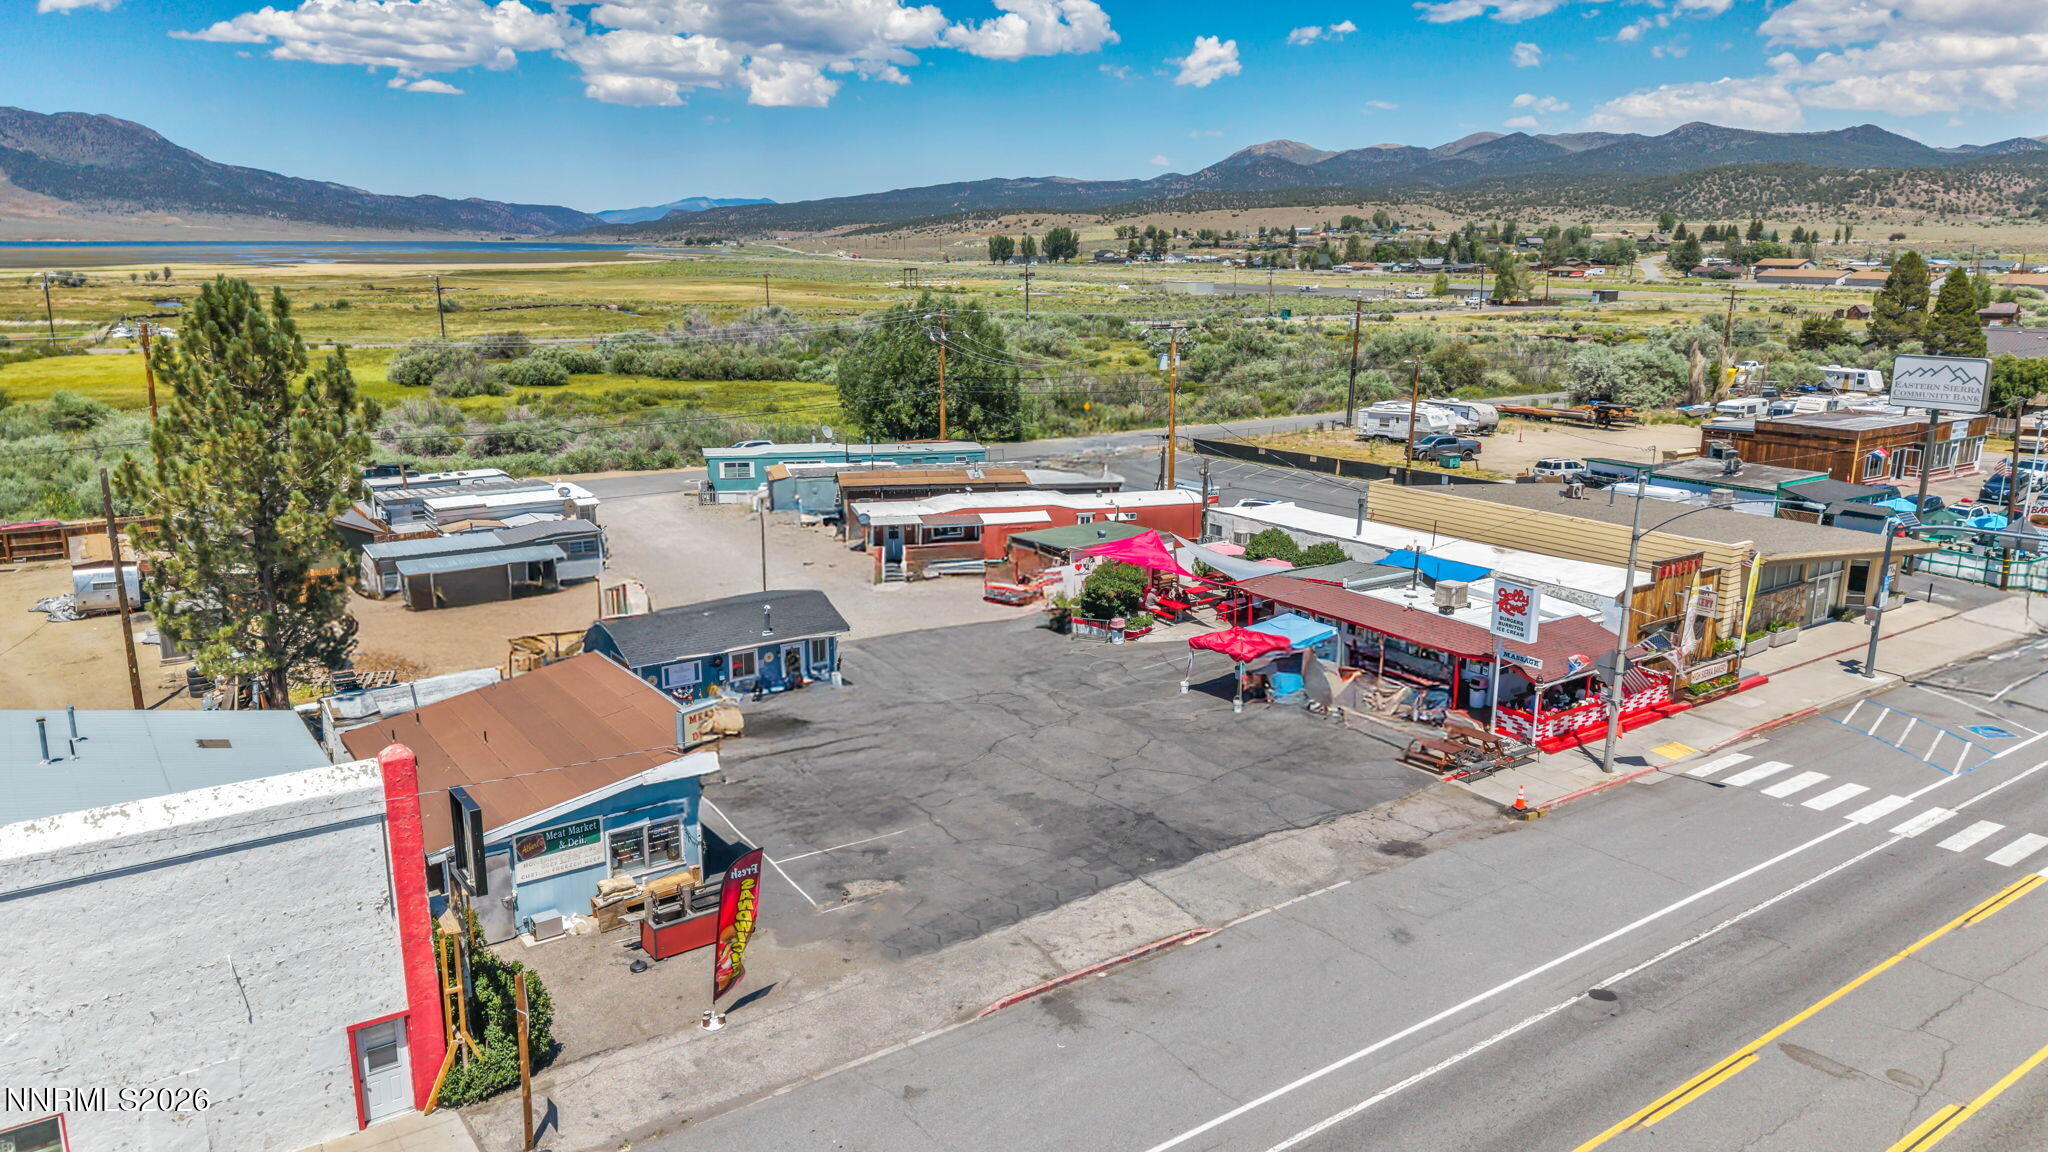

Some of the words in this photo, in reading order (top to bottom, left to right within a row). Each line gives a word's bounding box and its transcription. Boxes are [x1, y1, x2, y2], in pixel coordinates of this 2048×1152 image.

[1894, 381, 1940, 391] EASTERN
[1943, 384, 1982, 393] SIERRA
[1893, 389, 1952, 400] COMMUNITY
[1953, 393, 1980, 402] BANK
[1498, 621, 1524, 632] BURRITOS
[1499, 616, 1524, 626] BURGERS
[1506, 628, 1525, 638] CREAM
[1502, 651, 1540, 667] MASSAGE
[545, 828, 566, 841] Meat
[568, 821, 598, 835] Market
[558, 840, 567, 849] &
